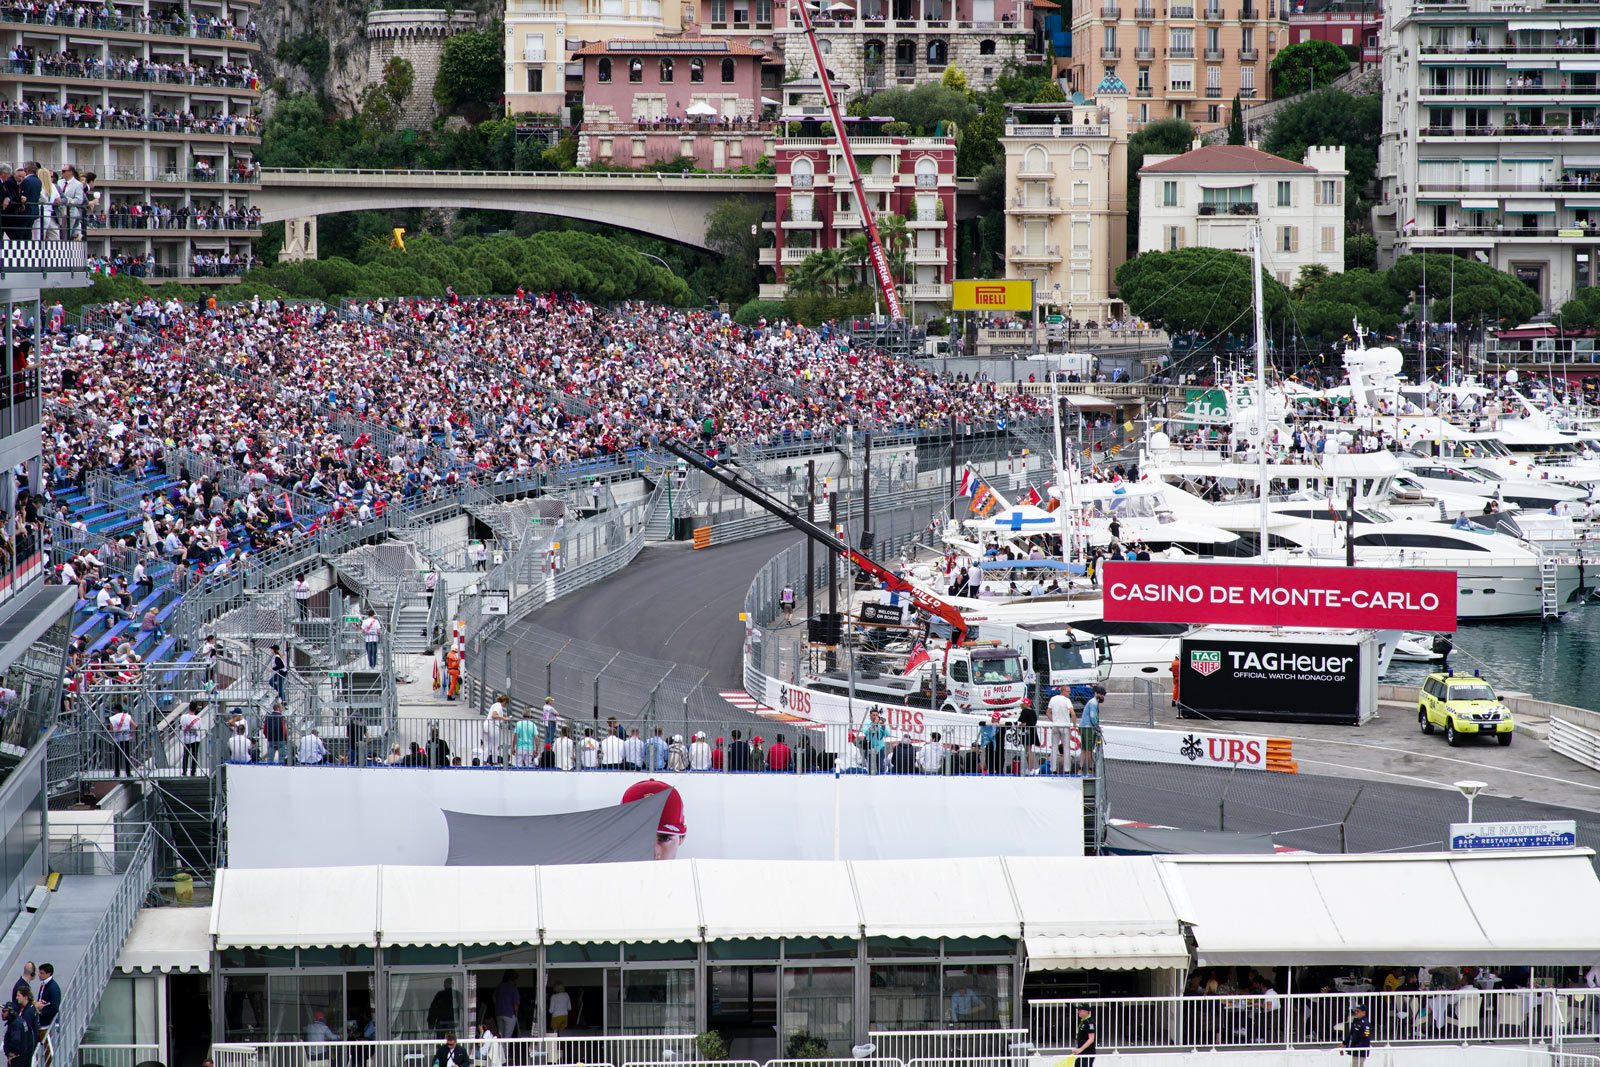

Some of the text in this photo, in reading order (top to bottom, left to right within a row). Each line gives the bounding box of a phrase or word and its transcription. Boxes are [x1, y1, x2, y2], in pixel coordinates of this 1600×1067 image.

[872, 245, 890, 286] IMPERIAL
[976, 287, 1006, 304] PIRELLI
[911, 587, 941, 607] MILLO
[1110, 583, 1439, 611] CASINO DE MONTE-CARLO
[1194, 652, 1218, 661] TAG
[1192, 662, 1219, 674] HEUER
[1233, 671, 1267, 679] OFFICIAL
[993, 685, 1013, 694] MILLO
[788, 688, 812, 714] UBS
[886, 707, 925, 734] UBS
[1032, 726, 1082, 751] US
[1207, 738, 1261, 764] UBS
[1480, 825, 1548, 837] LE NAUTIC
